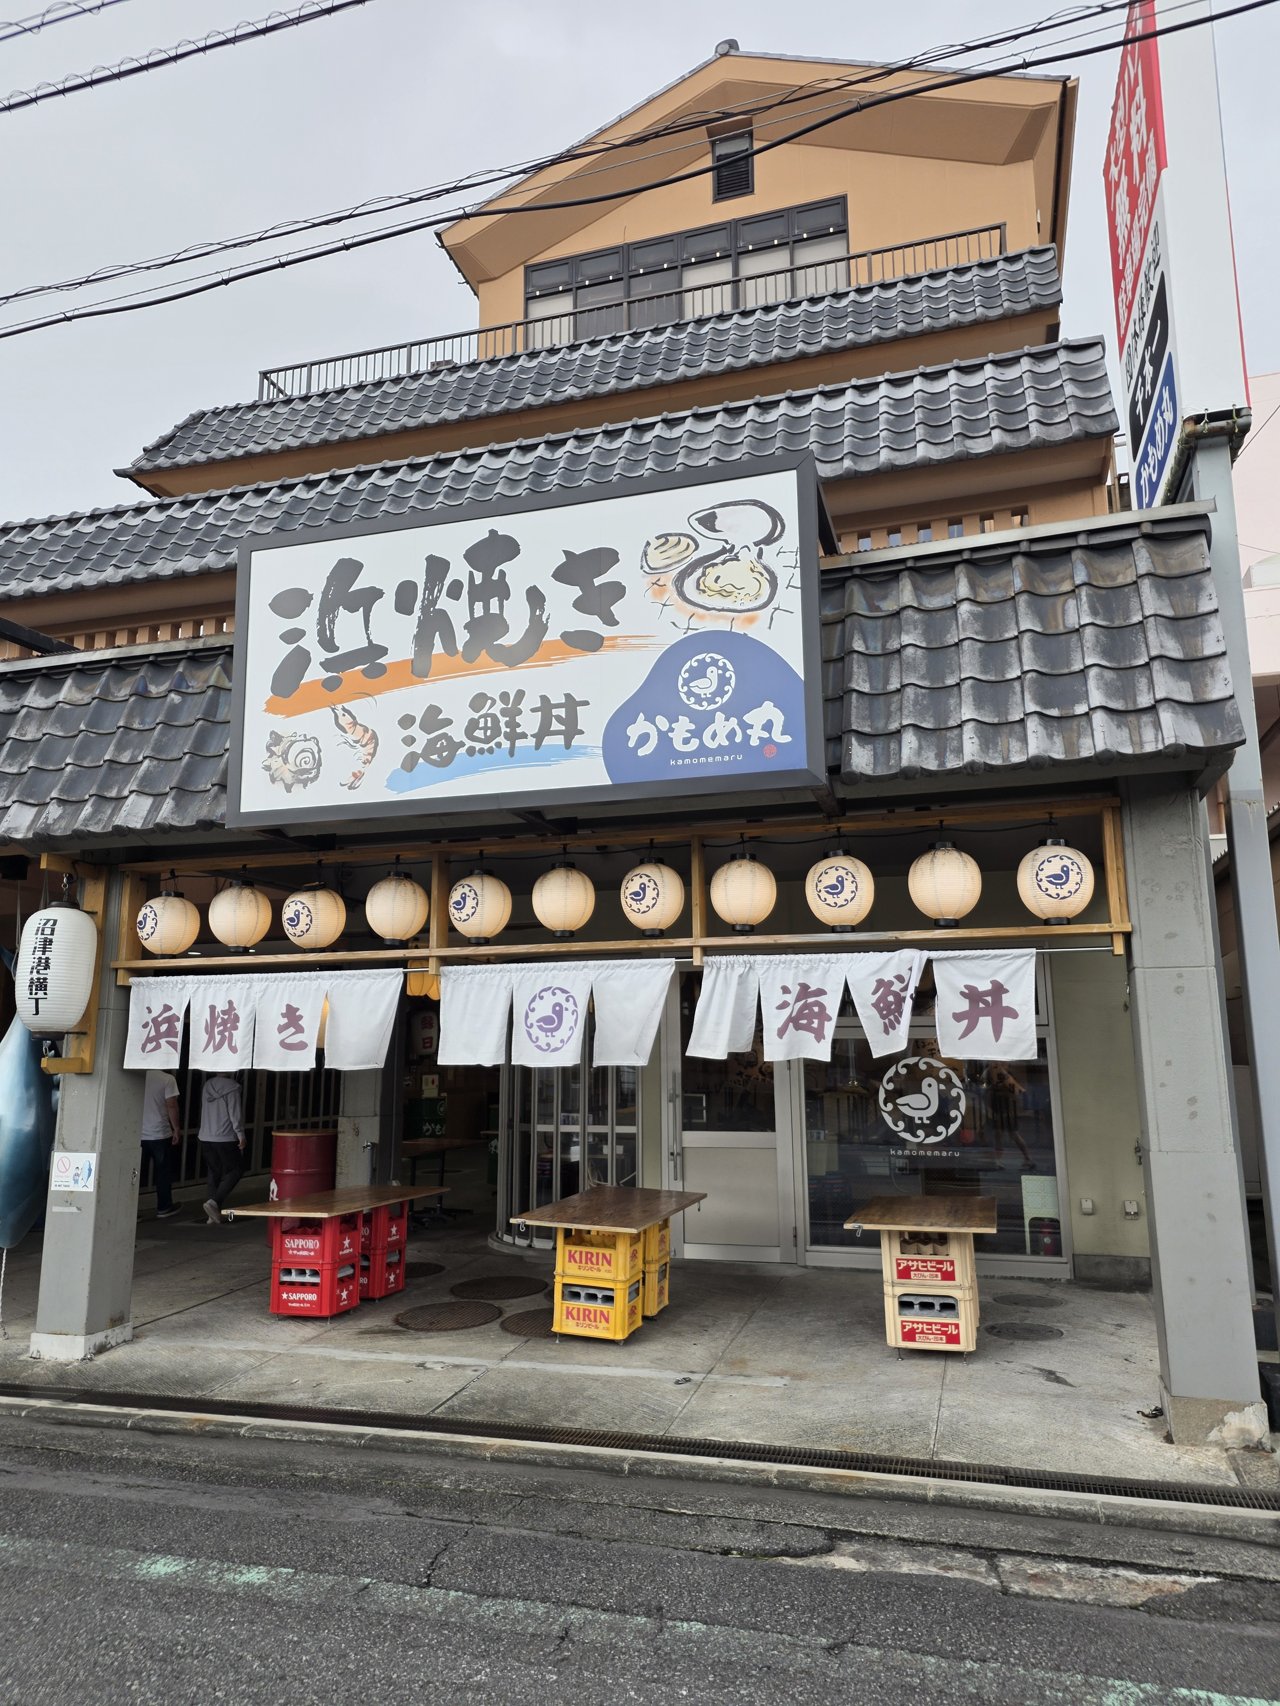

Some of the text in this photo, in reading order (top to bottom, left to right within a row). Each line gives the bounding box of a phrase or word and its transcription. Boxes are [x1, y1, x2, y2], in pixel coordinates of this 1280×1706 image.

[1135, 319, 1161, 426] 千本一
[1140, 385, 1174, 509] かもめ丸
[269, 528, 627, 699] 浜焼き
[397, 688, 592, 774] 海鮮丼
[625, 701, 793, 759] かもめ丸
[669, 753, 744, 766] kamomemaru
[28, 918, 58, 1016] 沼津港横丁
[140, 999, 308, 1054] 浜焼き
[890, 1149, 961, 1158] kamomemaru
[284, 1238, 320, 1249] SAPPORO
[567, 1249, 612, 1268] KIRIN
[897, 1259, 954, 1272] アサヒビール
[288, 1292, 318, 1301] SAPPORO
[565, 1305, 611, 1325] KIRIN
[902, 1322, 958, 1335] アサヒビール
